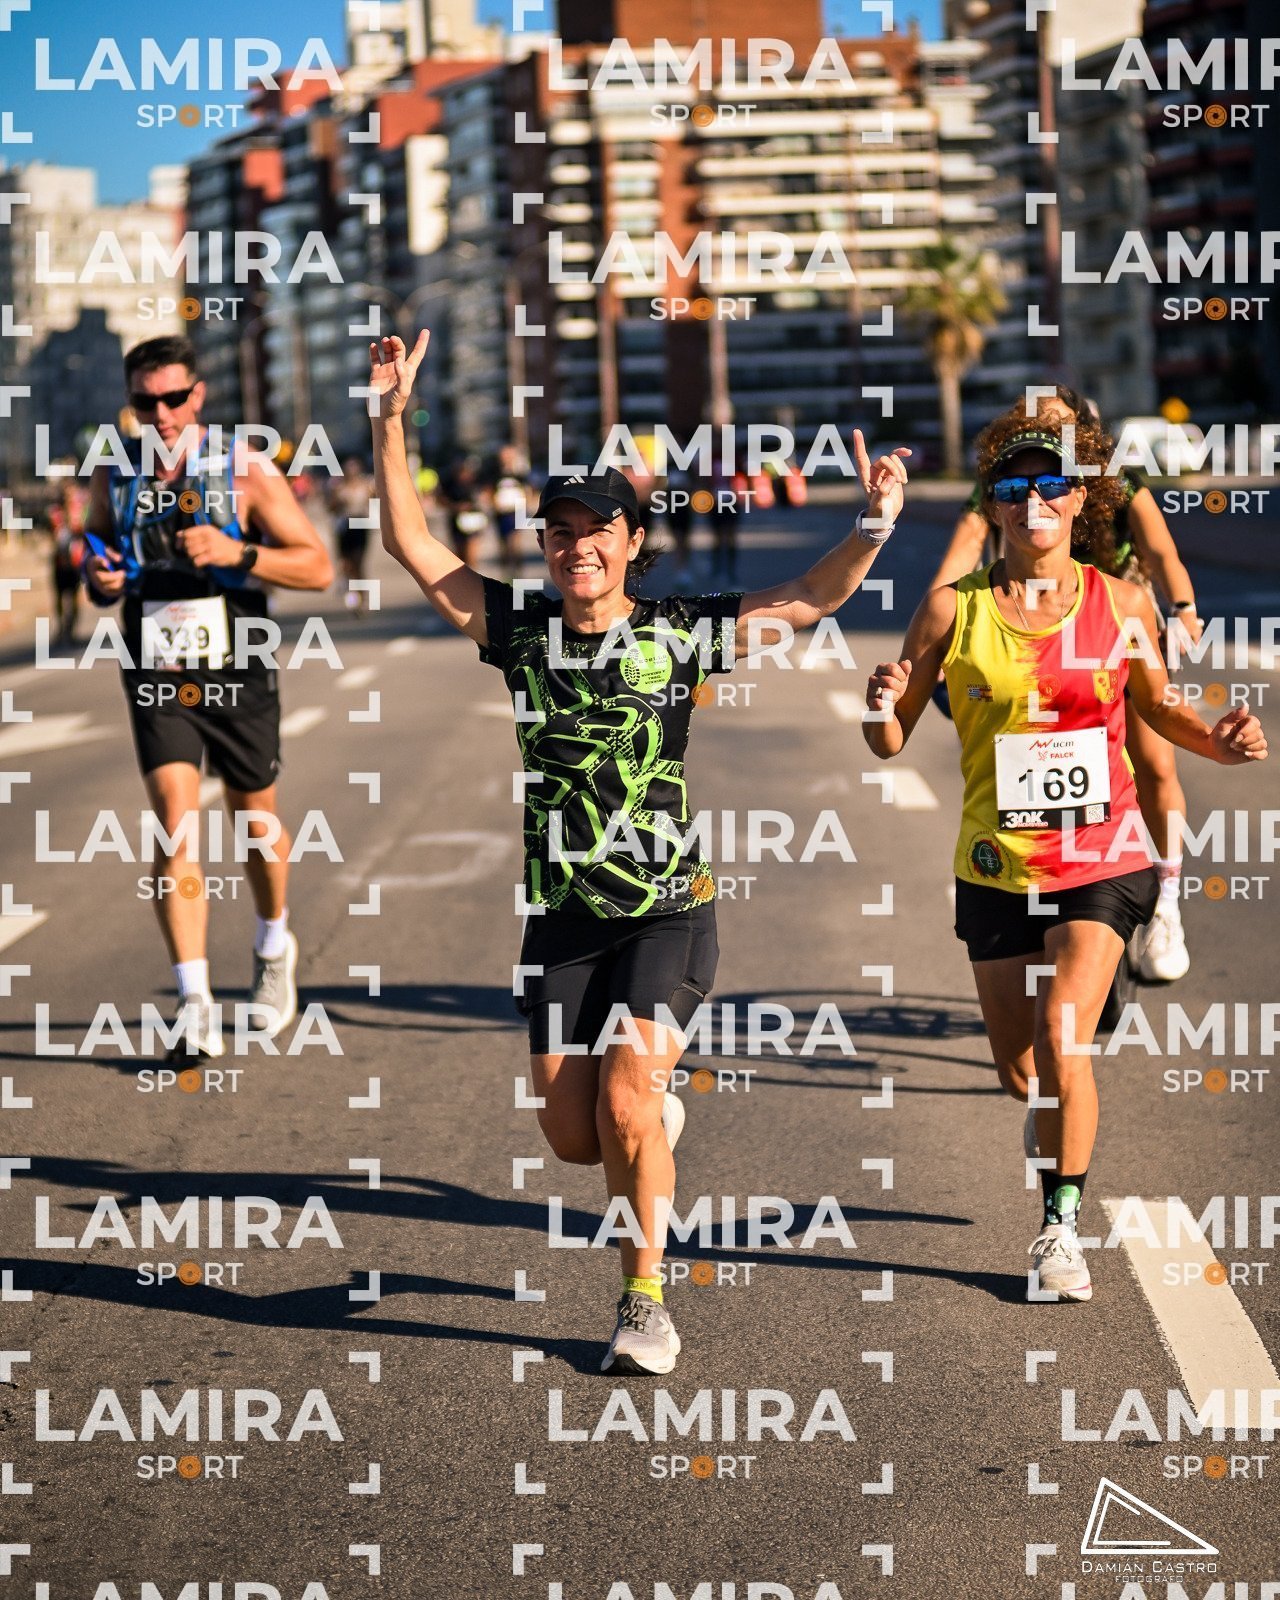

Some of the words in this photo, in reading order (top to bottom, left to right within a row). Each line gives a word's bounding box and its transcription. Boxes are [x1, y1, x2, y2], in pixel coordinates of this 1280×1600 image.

[1050, 751, 1074, 759] FALCK
[1018, 765, 1090, 802] 169
[1005, 811, 1045, 829] 30K
